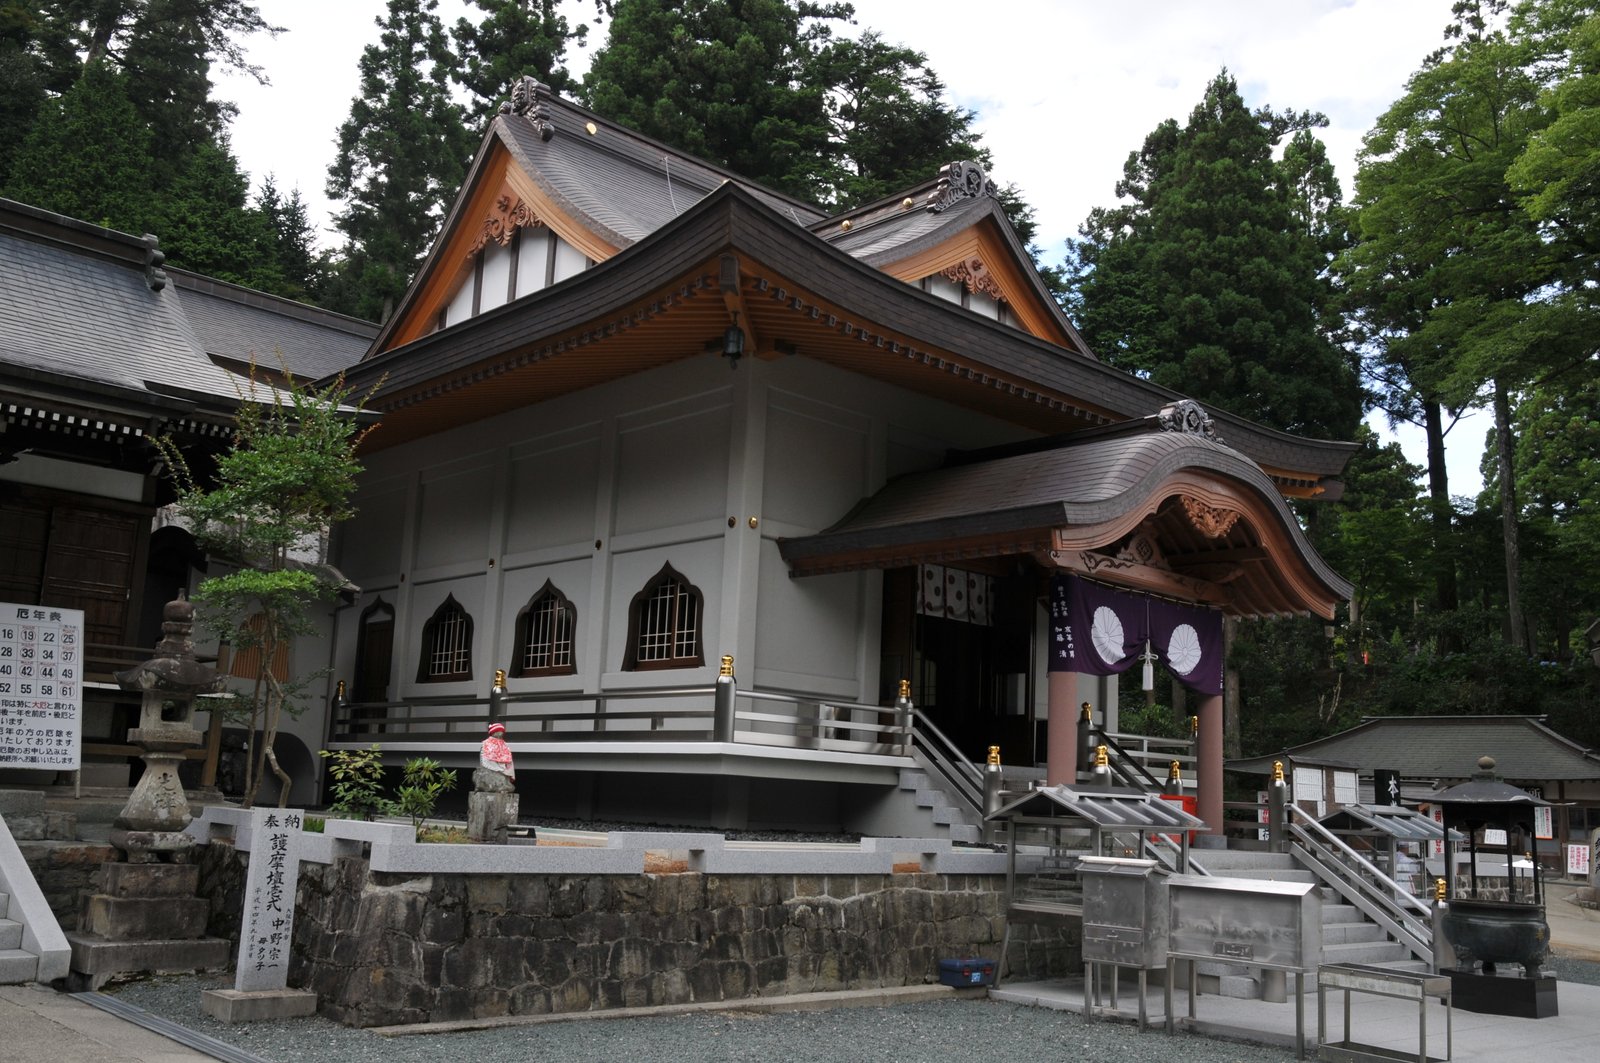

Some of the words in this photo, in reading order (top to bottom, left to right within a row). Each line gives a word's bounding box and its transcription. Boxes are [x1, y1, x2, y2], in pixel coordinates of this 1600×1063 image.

[16, 608, 62, 622] 厄年表
[2, 628, 13, 639] 16
[23, 630, 34, 641] 19
[43, 632, 55, 642] 22
[62, 634, 74, 644] 25
[1, 646, 13, 657] 28
[21, 648, 34, 658] 33
[42, 649, 54, 660] 34
[62, 651, 73, 661] 37
[0, 664, 12, 675] 40
[21, 666, 33, 676] 42
[41, 667, 53, 677] 44
[62, 669, 73, 679] 49
[0, 683, 11, 693] 52
[20, 684, 32, 694] 55
[41, 685, 53, 695] 58
[62, 687, 72, 696] 61
[0, 708, 75, 720] 後一年を前厄・後厄と
[264, 813, 300, 829] 奉納
